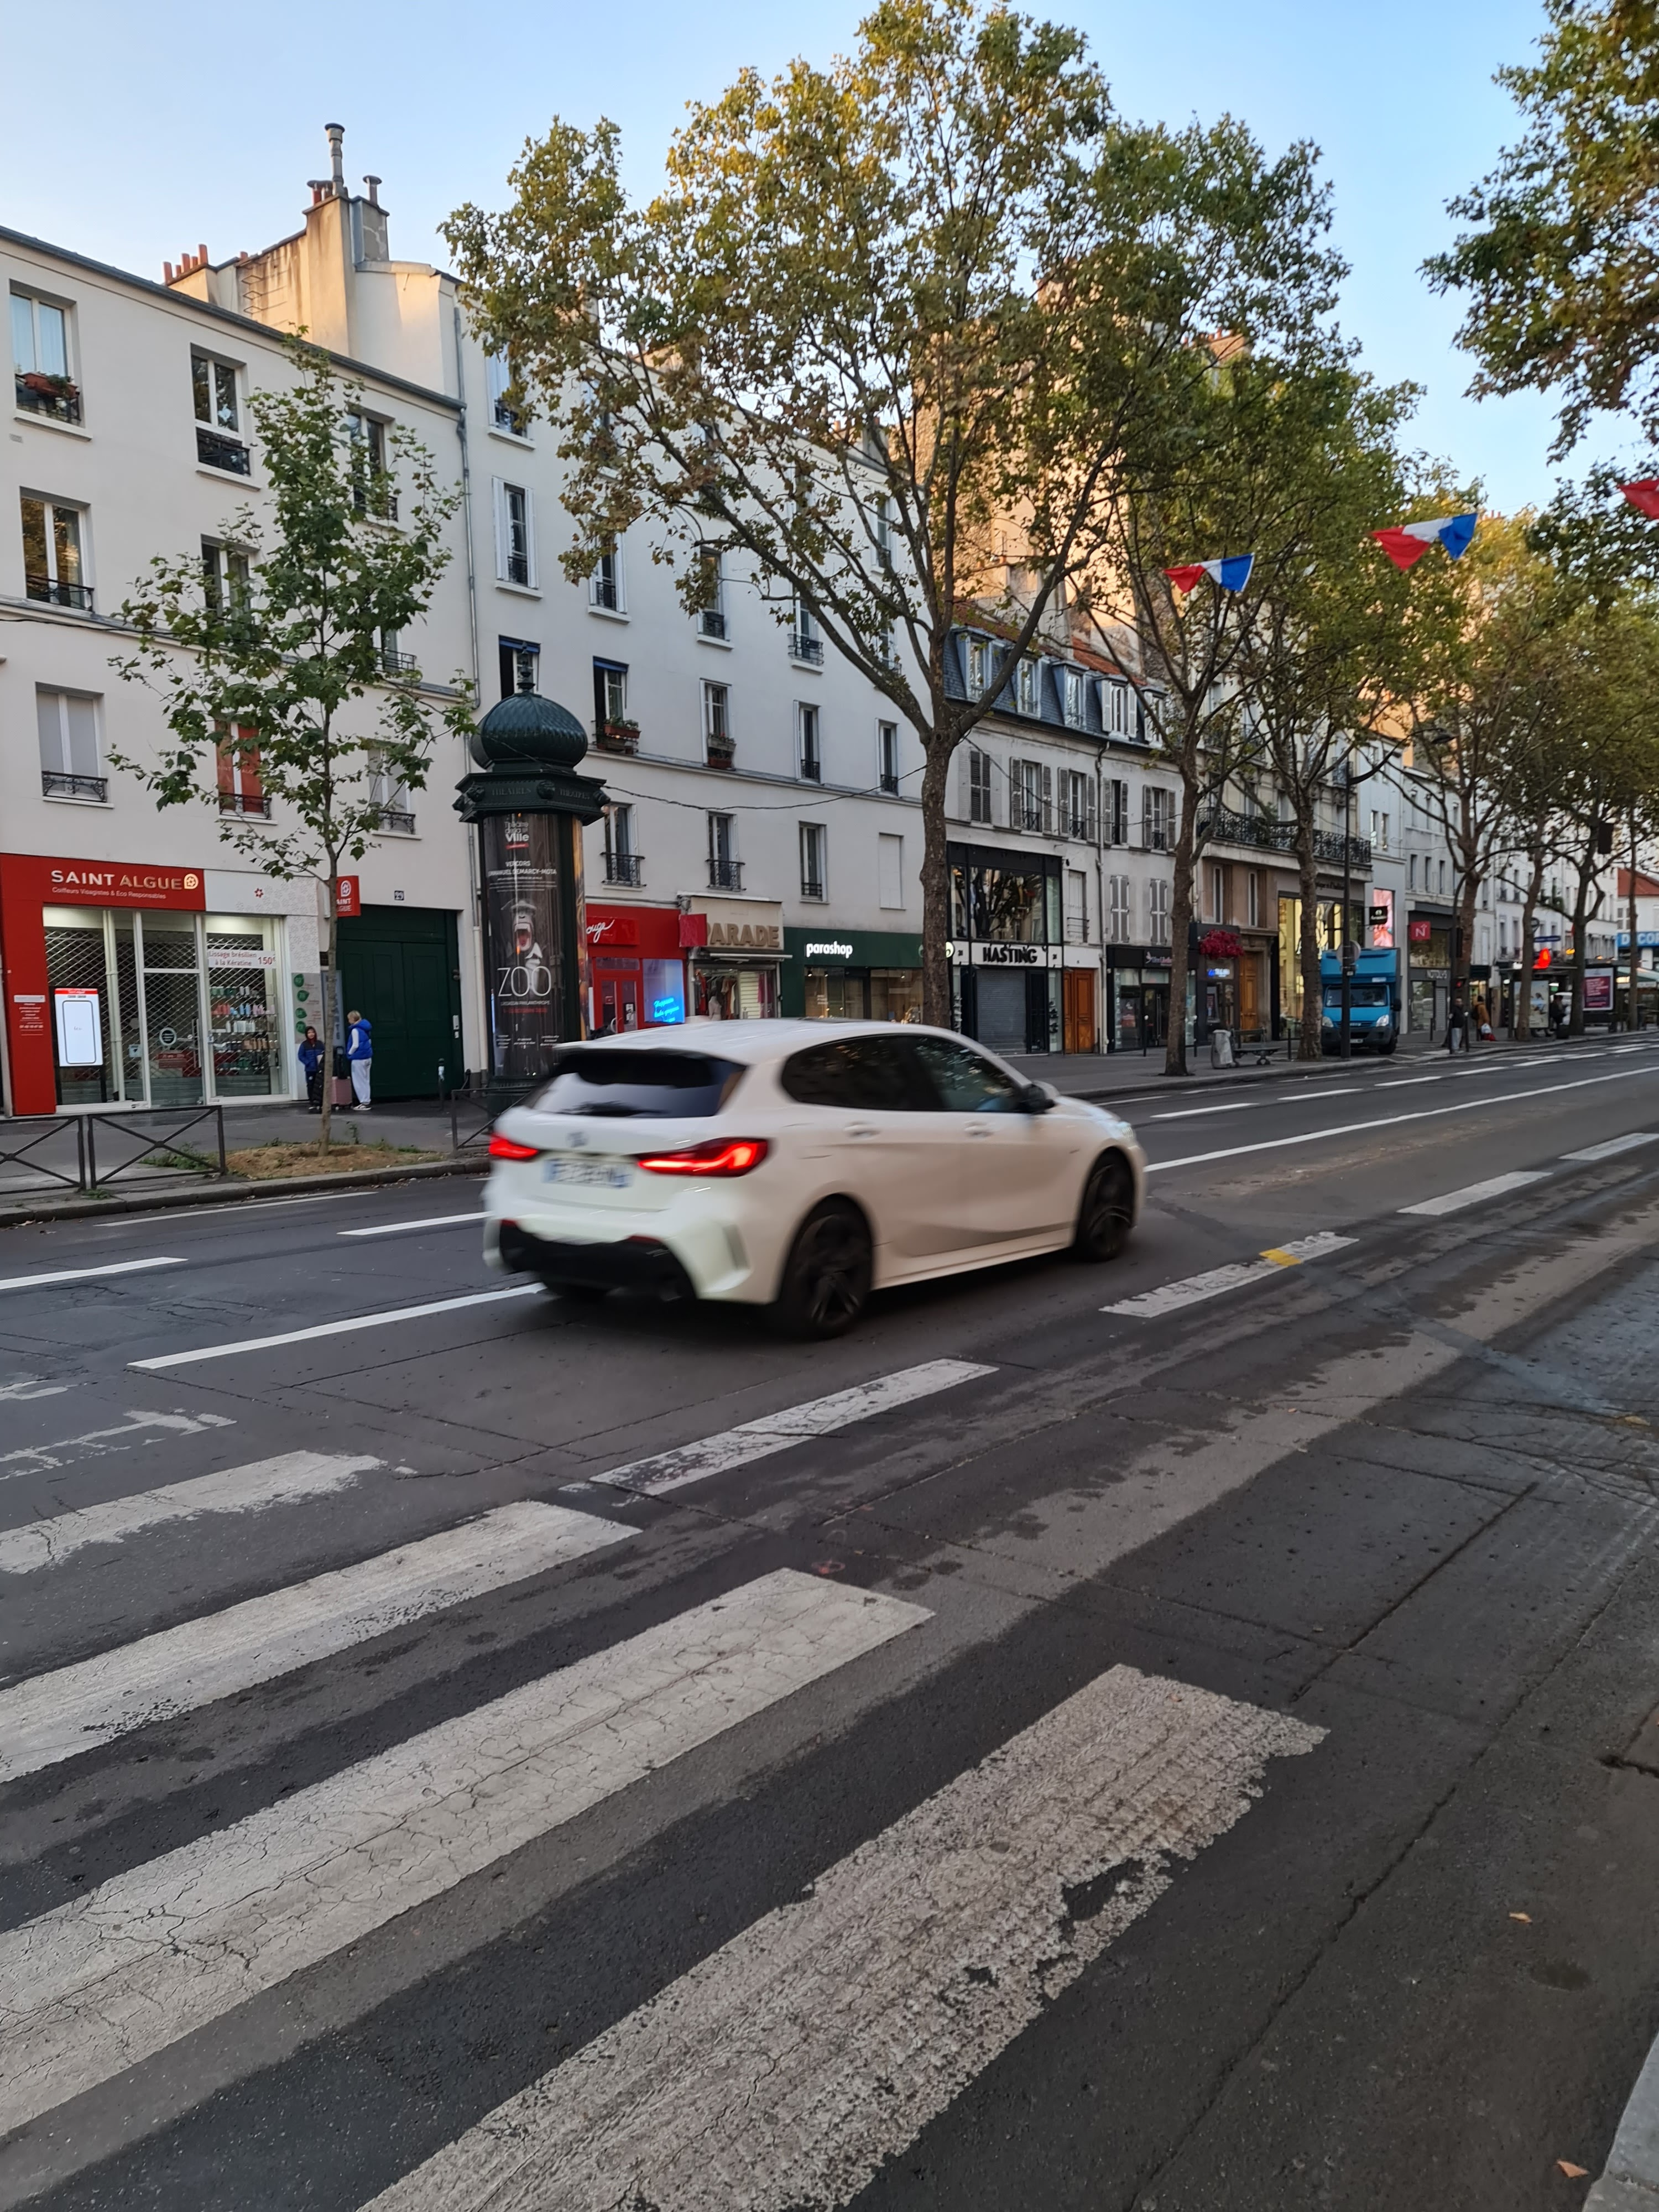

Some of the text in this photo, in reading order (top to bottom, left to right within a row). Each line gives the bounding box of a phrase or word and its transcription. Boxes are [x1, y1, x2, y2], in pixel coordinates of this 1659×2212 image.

[505, 833, 529, 842] Ville
[50, 870, 182, 890] SAINT ALGUE
[806, 941, 853, 959] parashop
[983, 946, 1038, 964] HASTING
[497, 966, 551, 997] ZOO
